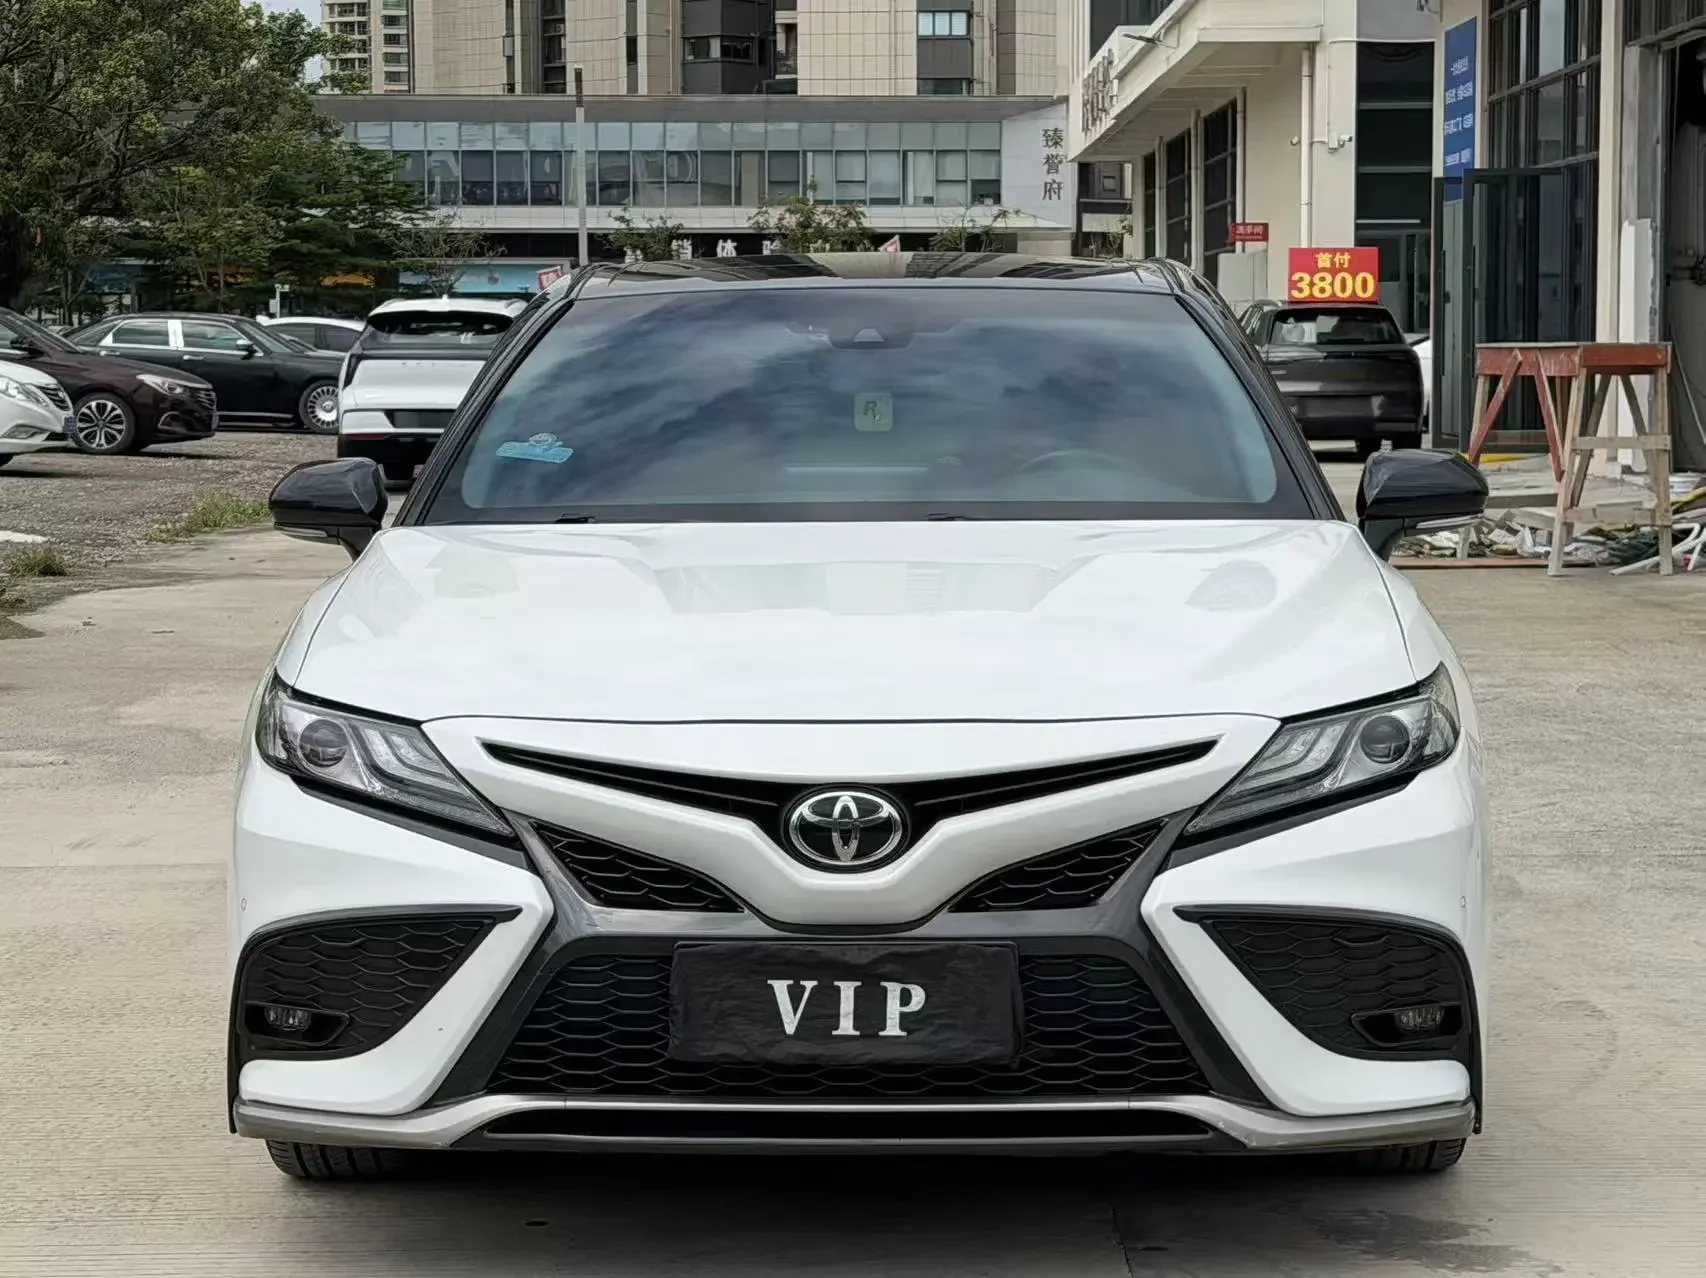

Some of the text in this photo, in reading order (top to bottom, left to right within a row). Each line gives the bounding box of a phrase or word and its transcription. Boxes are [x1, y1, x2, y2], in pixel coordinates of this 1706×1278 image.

[1315, 252, 1351, 268] 首付
[1291, 272, 1375, 299] 3800
[767, 979, 926, 1037] VIP
